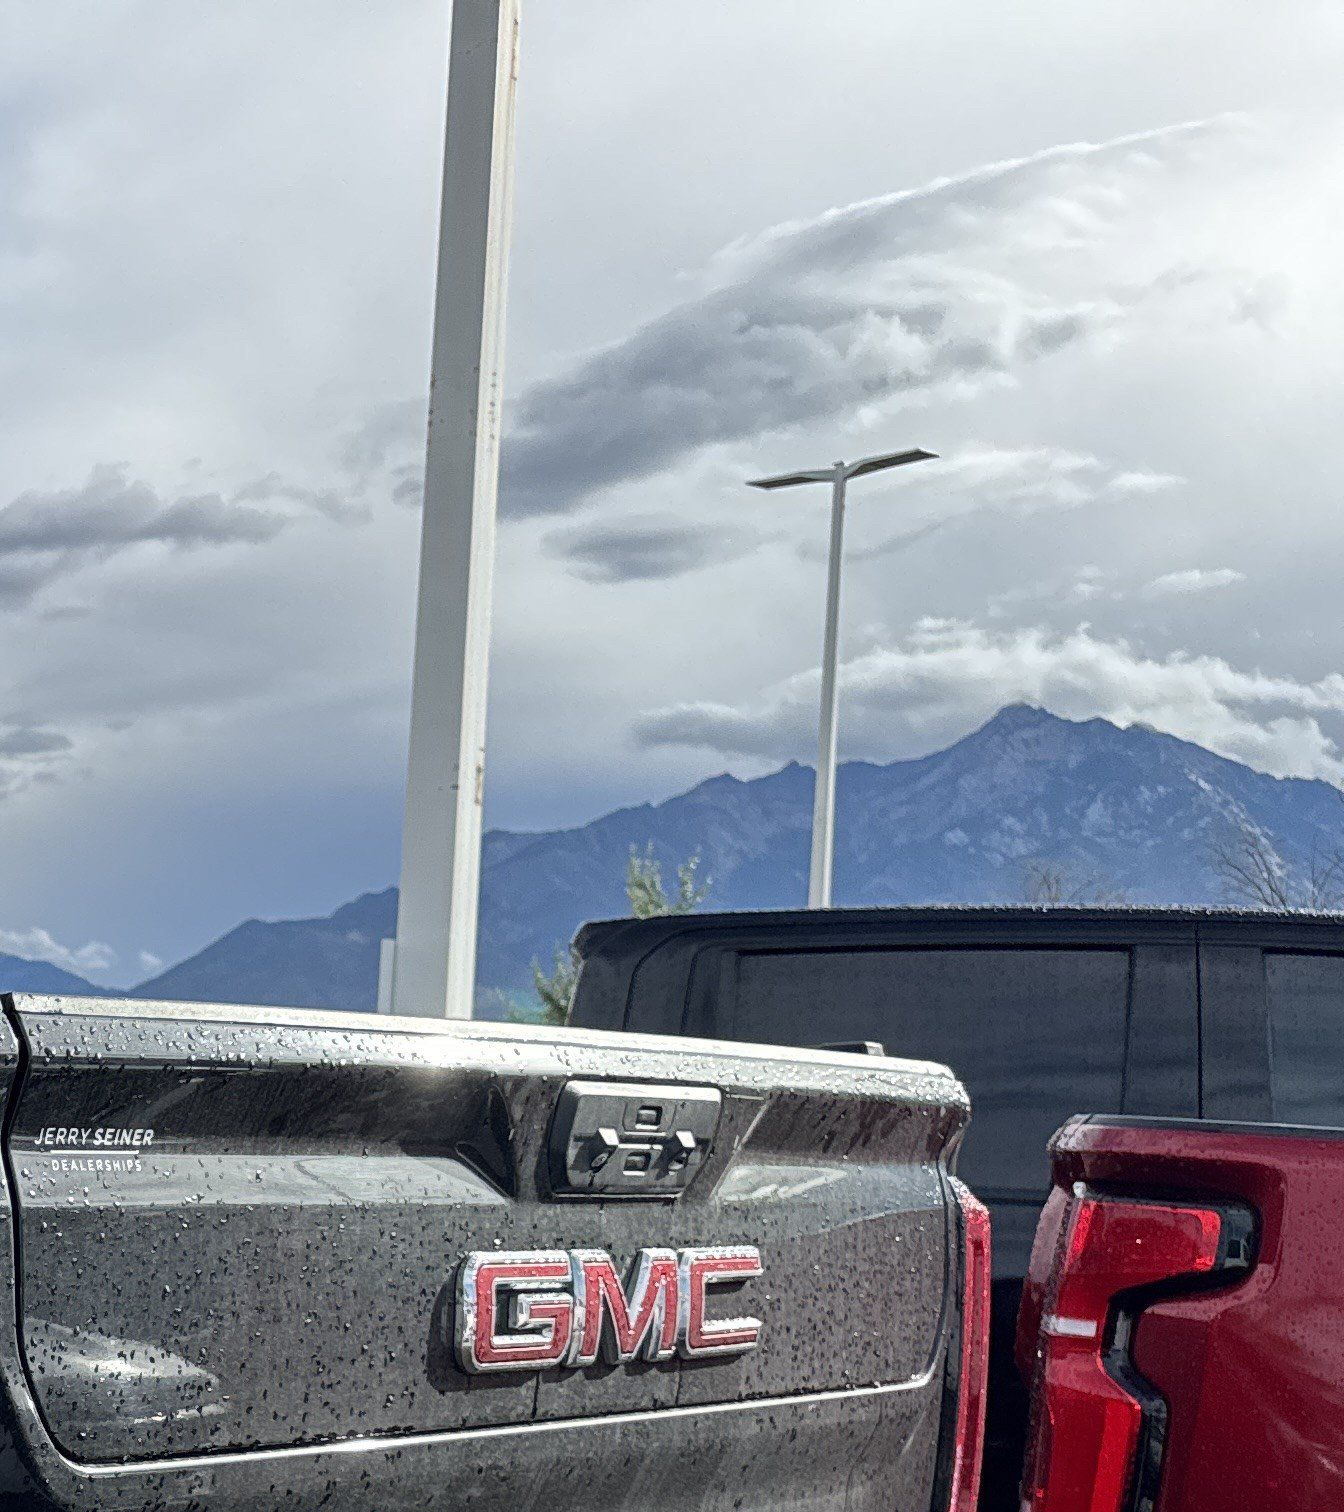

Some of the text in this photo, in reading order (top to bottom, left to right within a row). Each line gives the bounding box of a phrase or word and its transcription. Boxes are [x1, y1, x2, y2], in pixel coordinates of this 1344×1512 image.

[34, 1127, 154, 1146] JERRY SEINER
[52, 1159, 142, 1172] DEALERSHIPS
[456, 1246, 763, 1374] GMC
